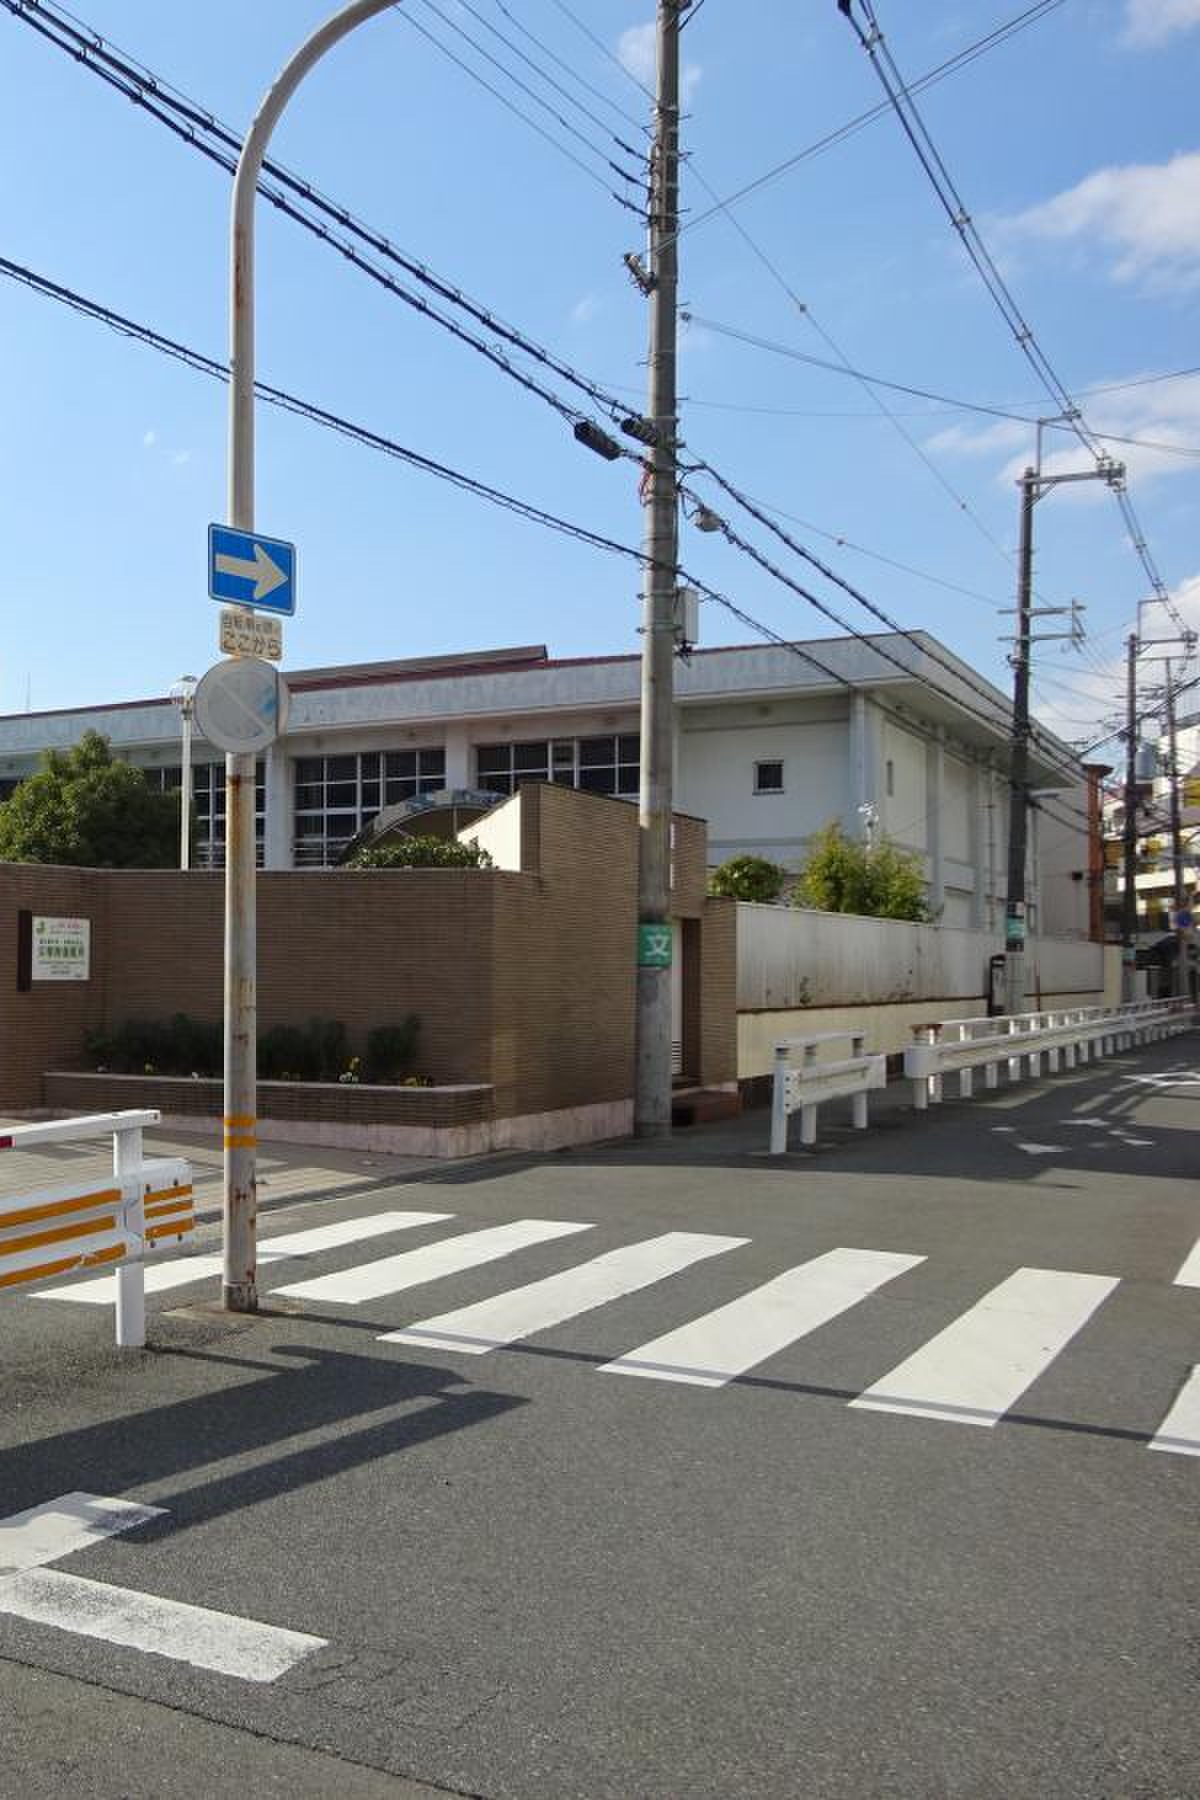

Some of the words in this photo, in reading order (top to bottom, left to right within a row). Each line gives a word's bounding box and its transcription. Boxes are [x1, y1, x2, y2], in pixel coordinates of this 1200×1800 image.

[223, 631, 281, 656] ここから
[645, 933, 670, 956] 文
